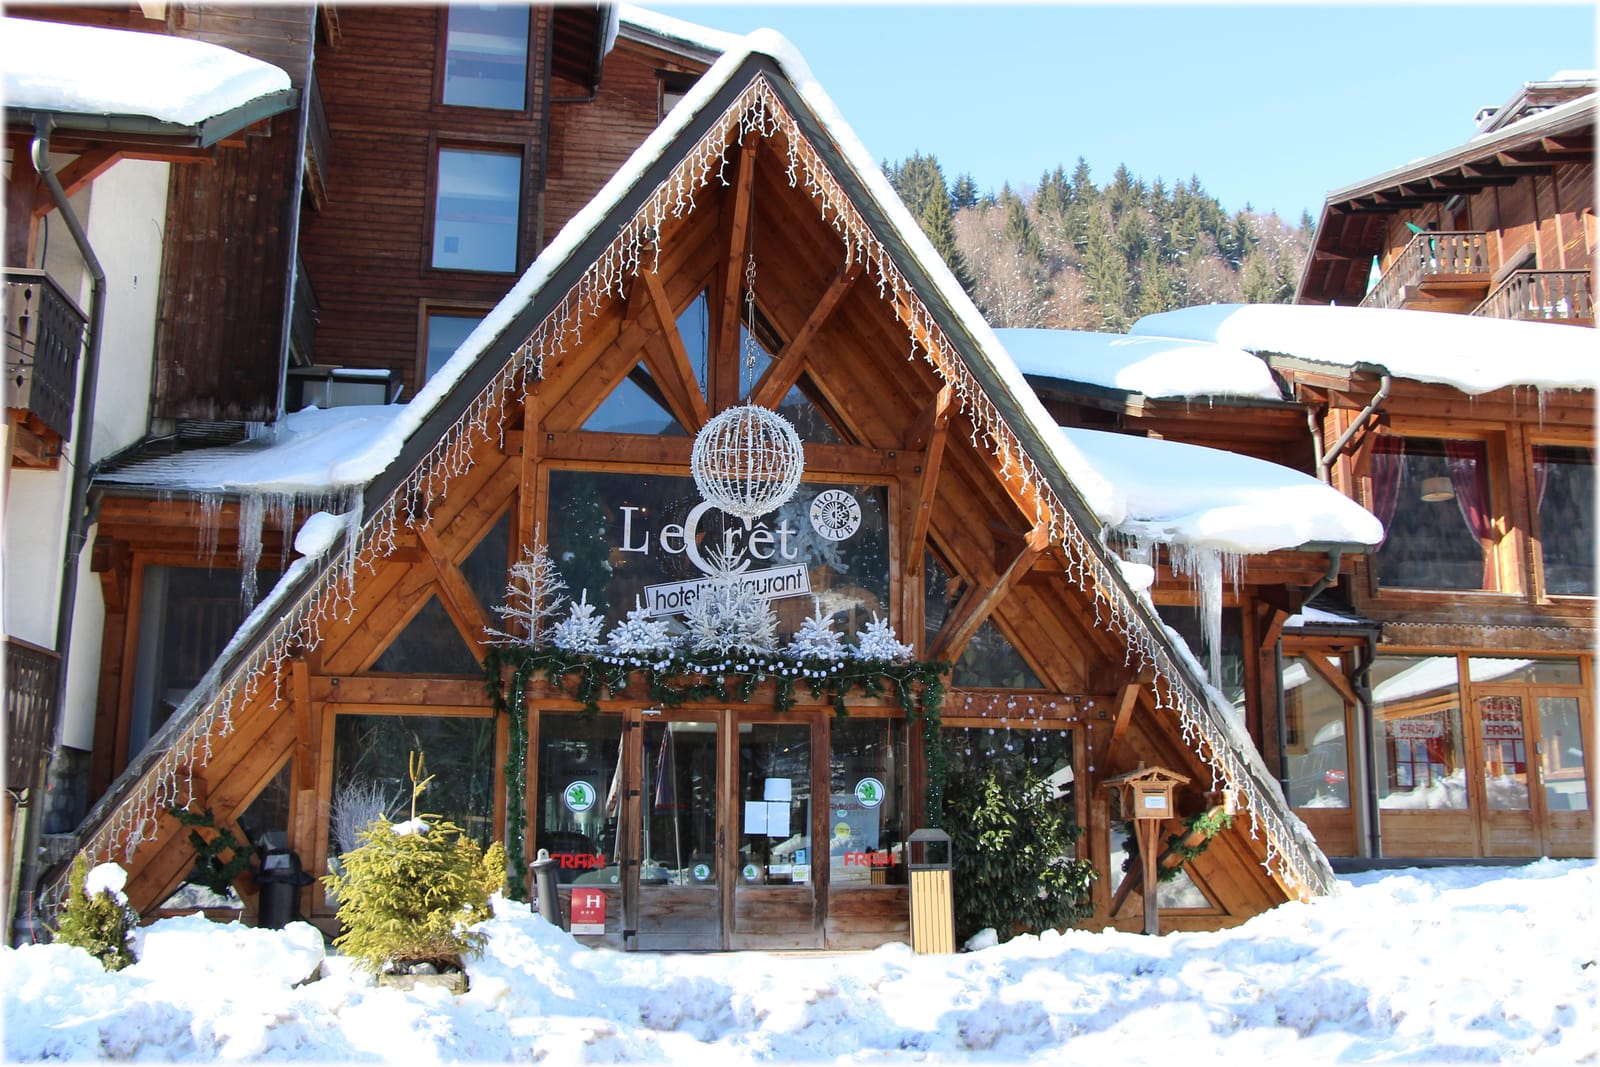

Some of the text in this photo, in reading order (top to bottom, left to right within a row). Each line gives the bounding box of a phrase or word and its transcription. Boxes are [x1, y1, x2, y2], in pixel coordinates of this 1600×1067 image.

[814, 491, 857, 511] HOTEL
[619, 500, 798, 577] Le Crêt
[818, 524, 854, 539] CLUB
[655, 583, 700, 610] hotel
[843, 851, 896, 868] FRAM
[586, 894, 601, 909] H
